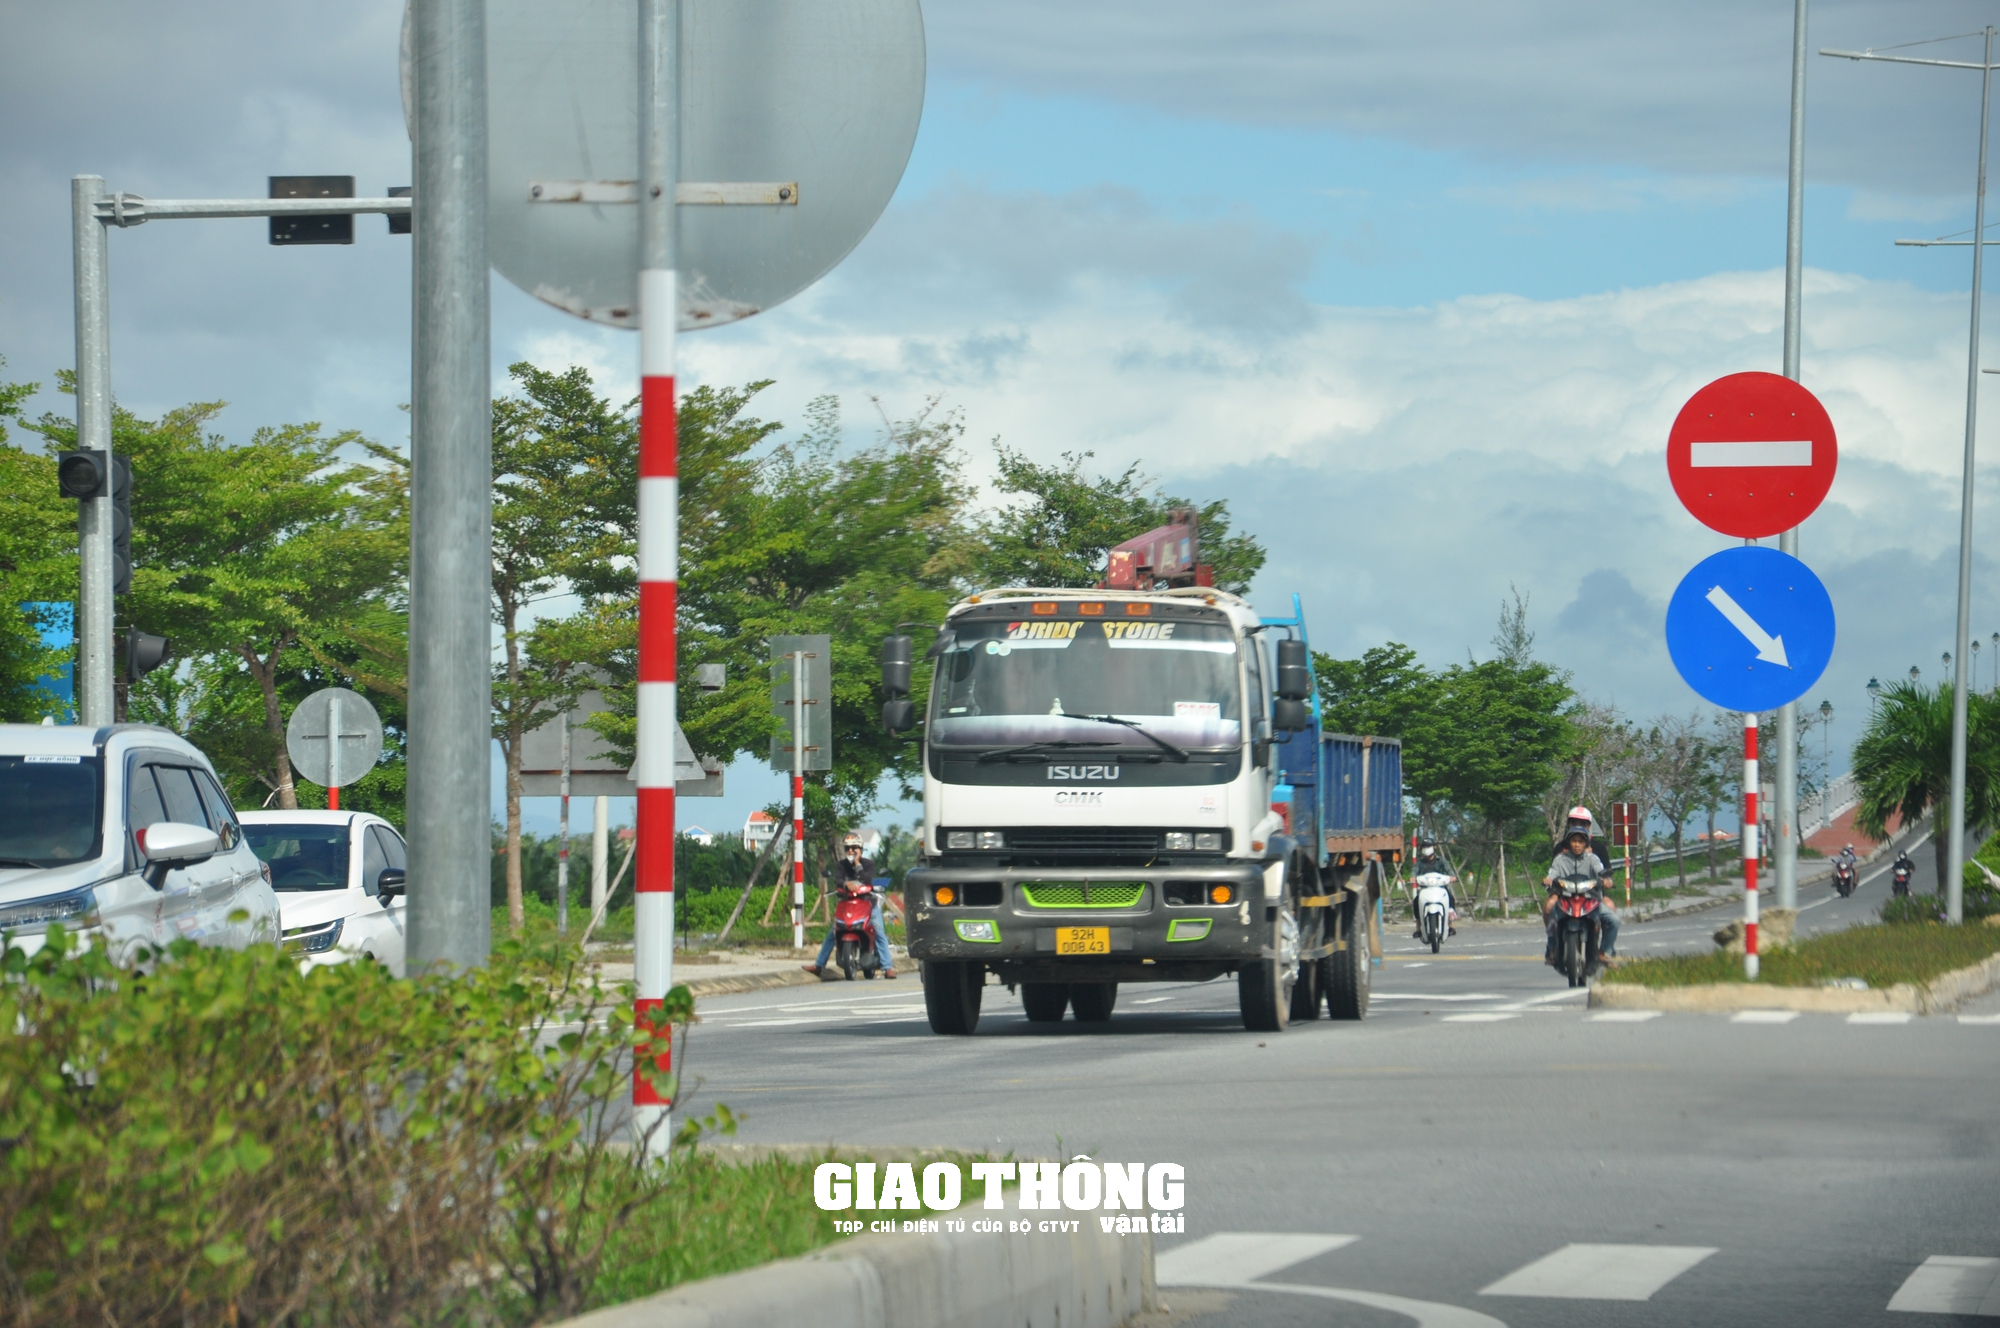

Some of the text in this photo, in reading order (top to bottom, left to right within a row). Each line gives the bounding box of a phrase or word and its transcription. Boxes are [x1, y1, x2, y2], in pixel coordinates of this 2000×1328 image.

[1047, 765, 1120, 780] ISUZU
[1054, 791, 1104, 804] CMK
[1071, 928, 1095, 940] 92H
[1062, 941, 1105, 953] 008.43
